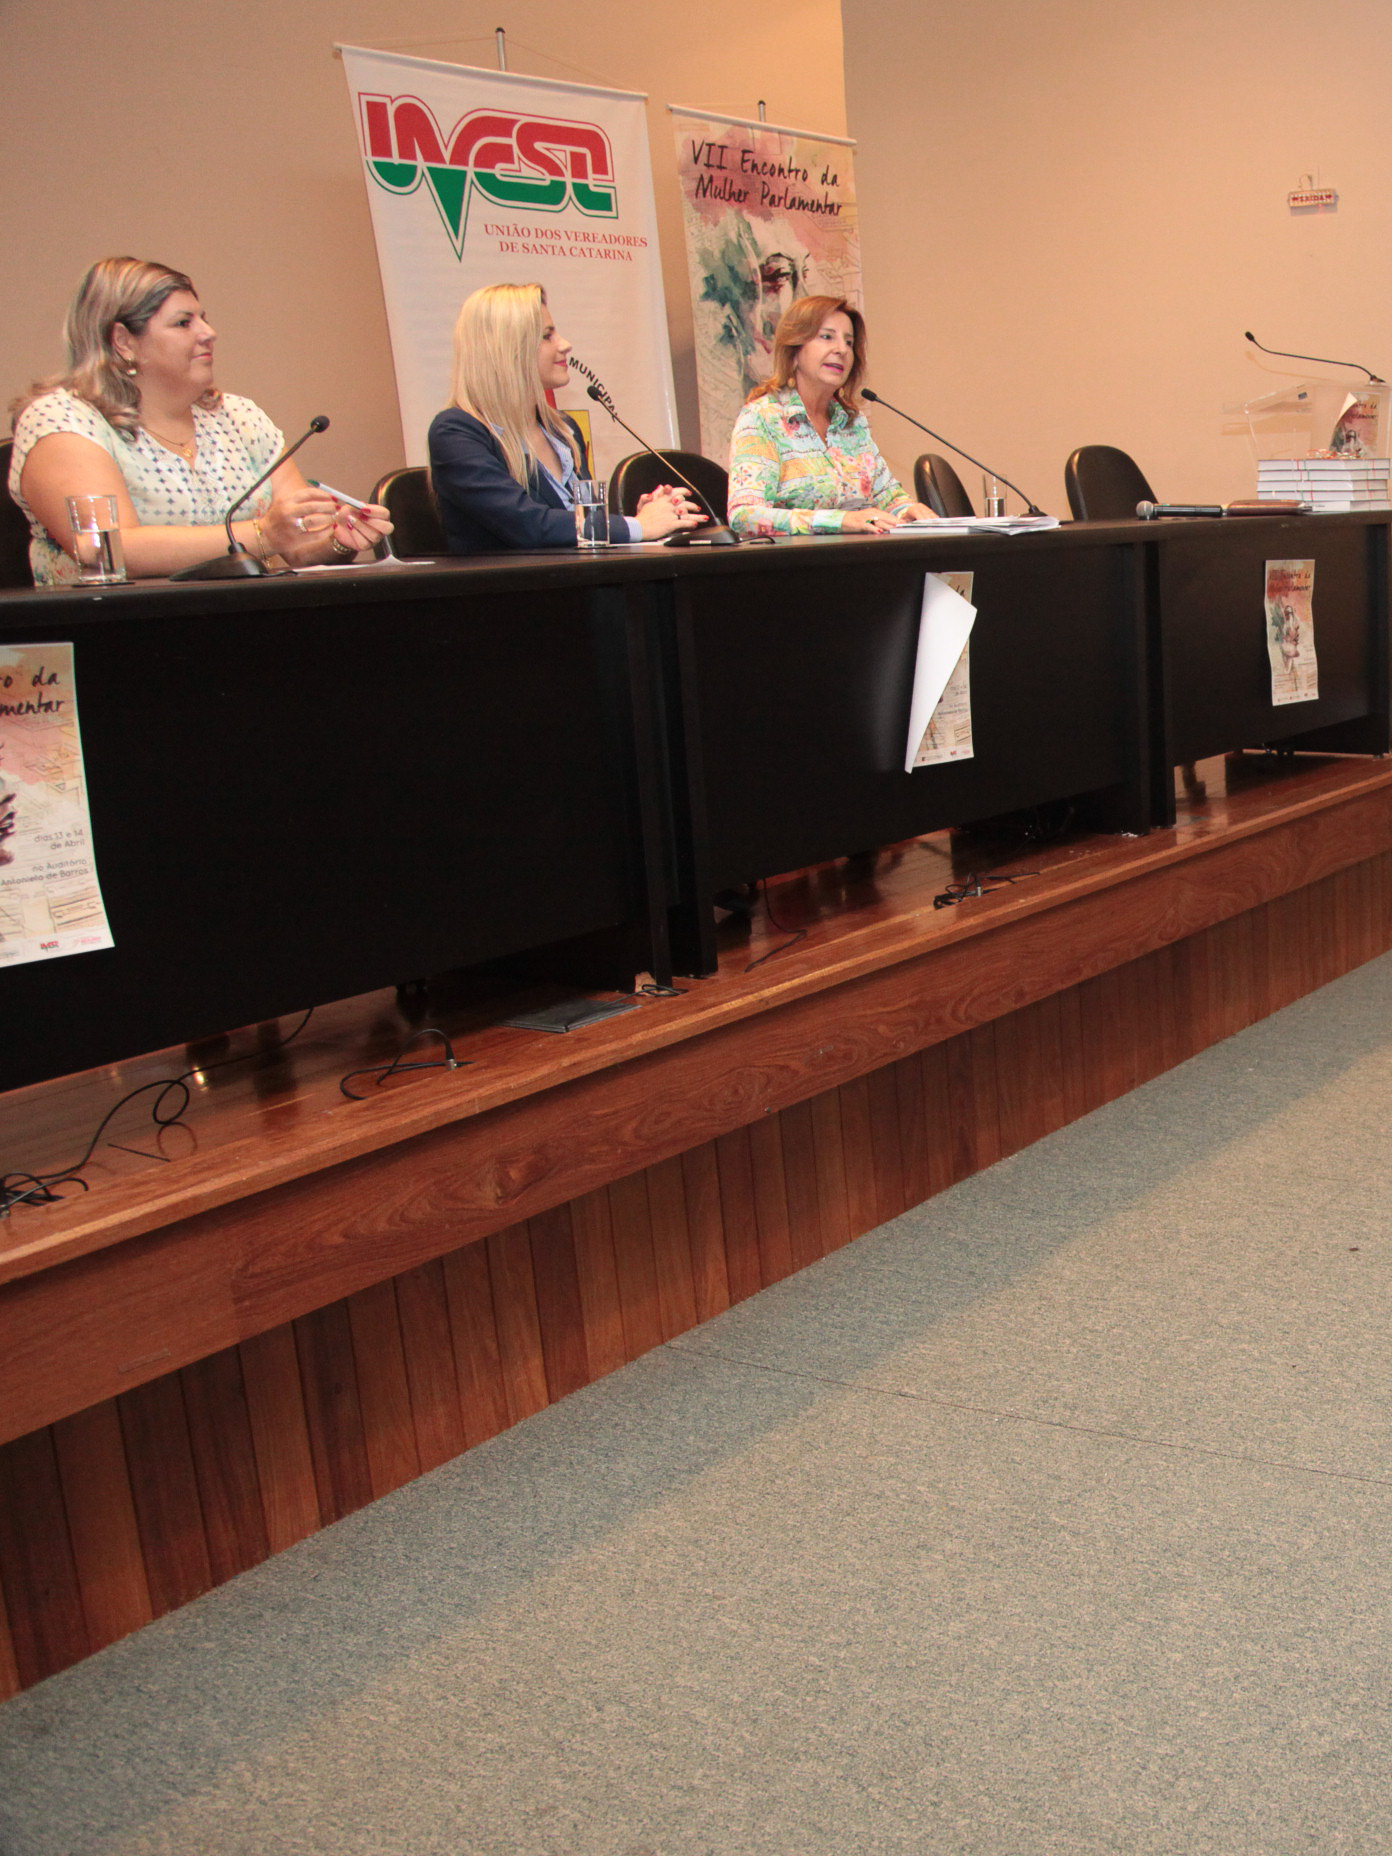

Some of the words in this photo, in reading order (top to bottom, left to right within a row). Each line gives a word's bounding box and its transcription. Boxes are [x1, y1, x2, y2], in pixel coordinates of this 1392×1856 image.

[691, 139, 729, 170] VII
[740, 149, 809, 182] Encontro
[820, 164, 840, 187] da
[695, 173, 750, 203] Mulher
[760, 181, 843, 216] Parlamentar
[483, 223, 531, 238] UNIÃO
[534, 228, 562, 240] DOS
[564, 230, 648, 248] VEREADORES
[499, 241, 520, 253] DE
[521, 242, 567, 257] SANTA
[569, 246, 633, 261] CATARINA
[32, 666, 61, 687] da
